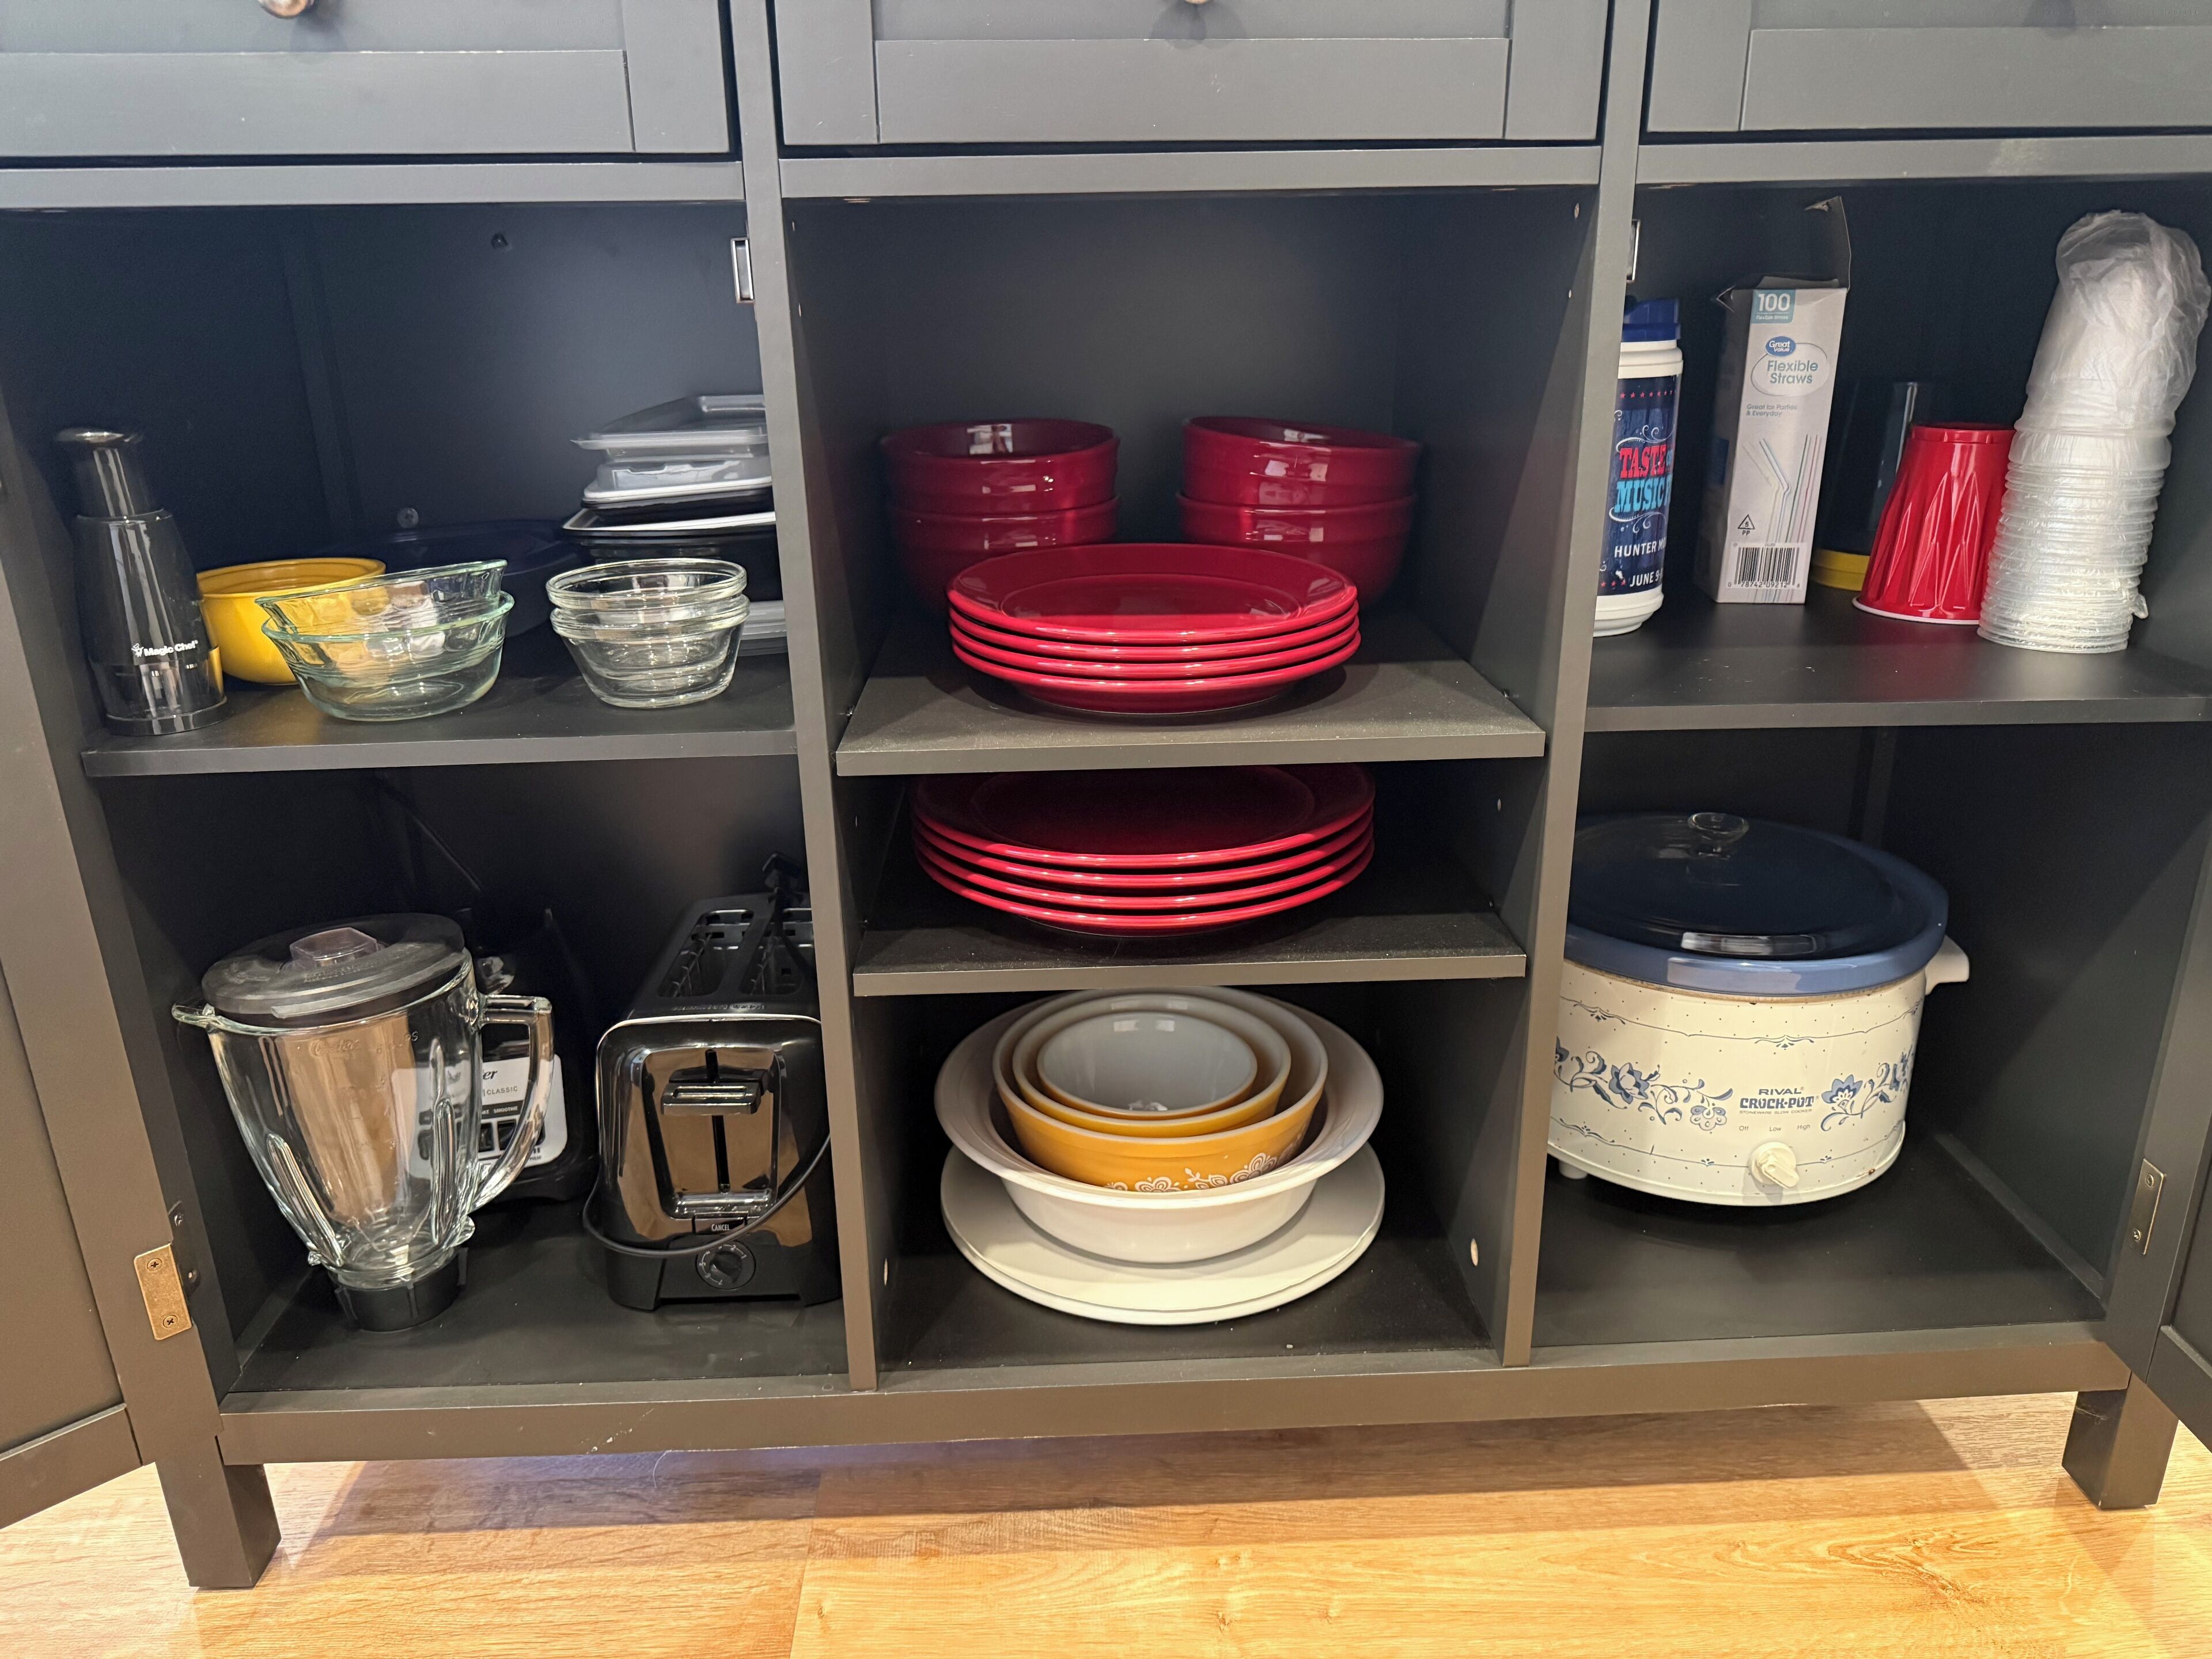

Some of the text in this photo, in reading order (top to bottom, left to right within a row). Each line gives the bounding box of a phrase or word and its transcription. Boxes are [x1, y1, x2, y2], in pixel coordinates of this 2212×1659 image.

[1759, 293, 1790, 312] 100
[1767, 360, 1819, 372] Flexible
[1770, 373, 1813, 384] Straws
[1619, 444, 1666, 479] TASTE
[1613, 476, 1665, 513] MUSIC
[1614, 540, 1657, 558] HUNTER
[1630, 571, 1654, 588] JUNE
[143, 641, 196, 656] Magic Chef
[487, 1086, 518, 1095] CLASSIC
[494, 1106, 518, 1114] SMOOTHIE
